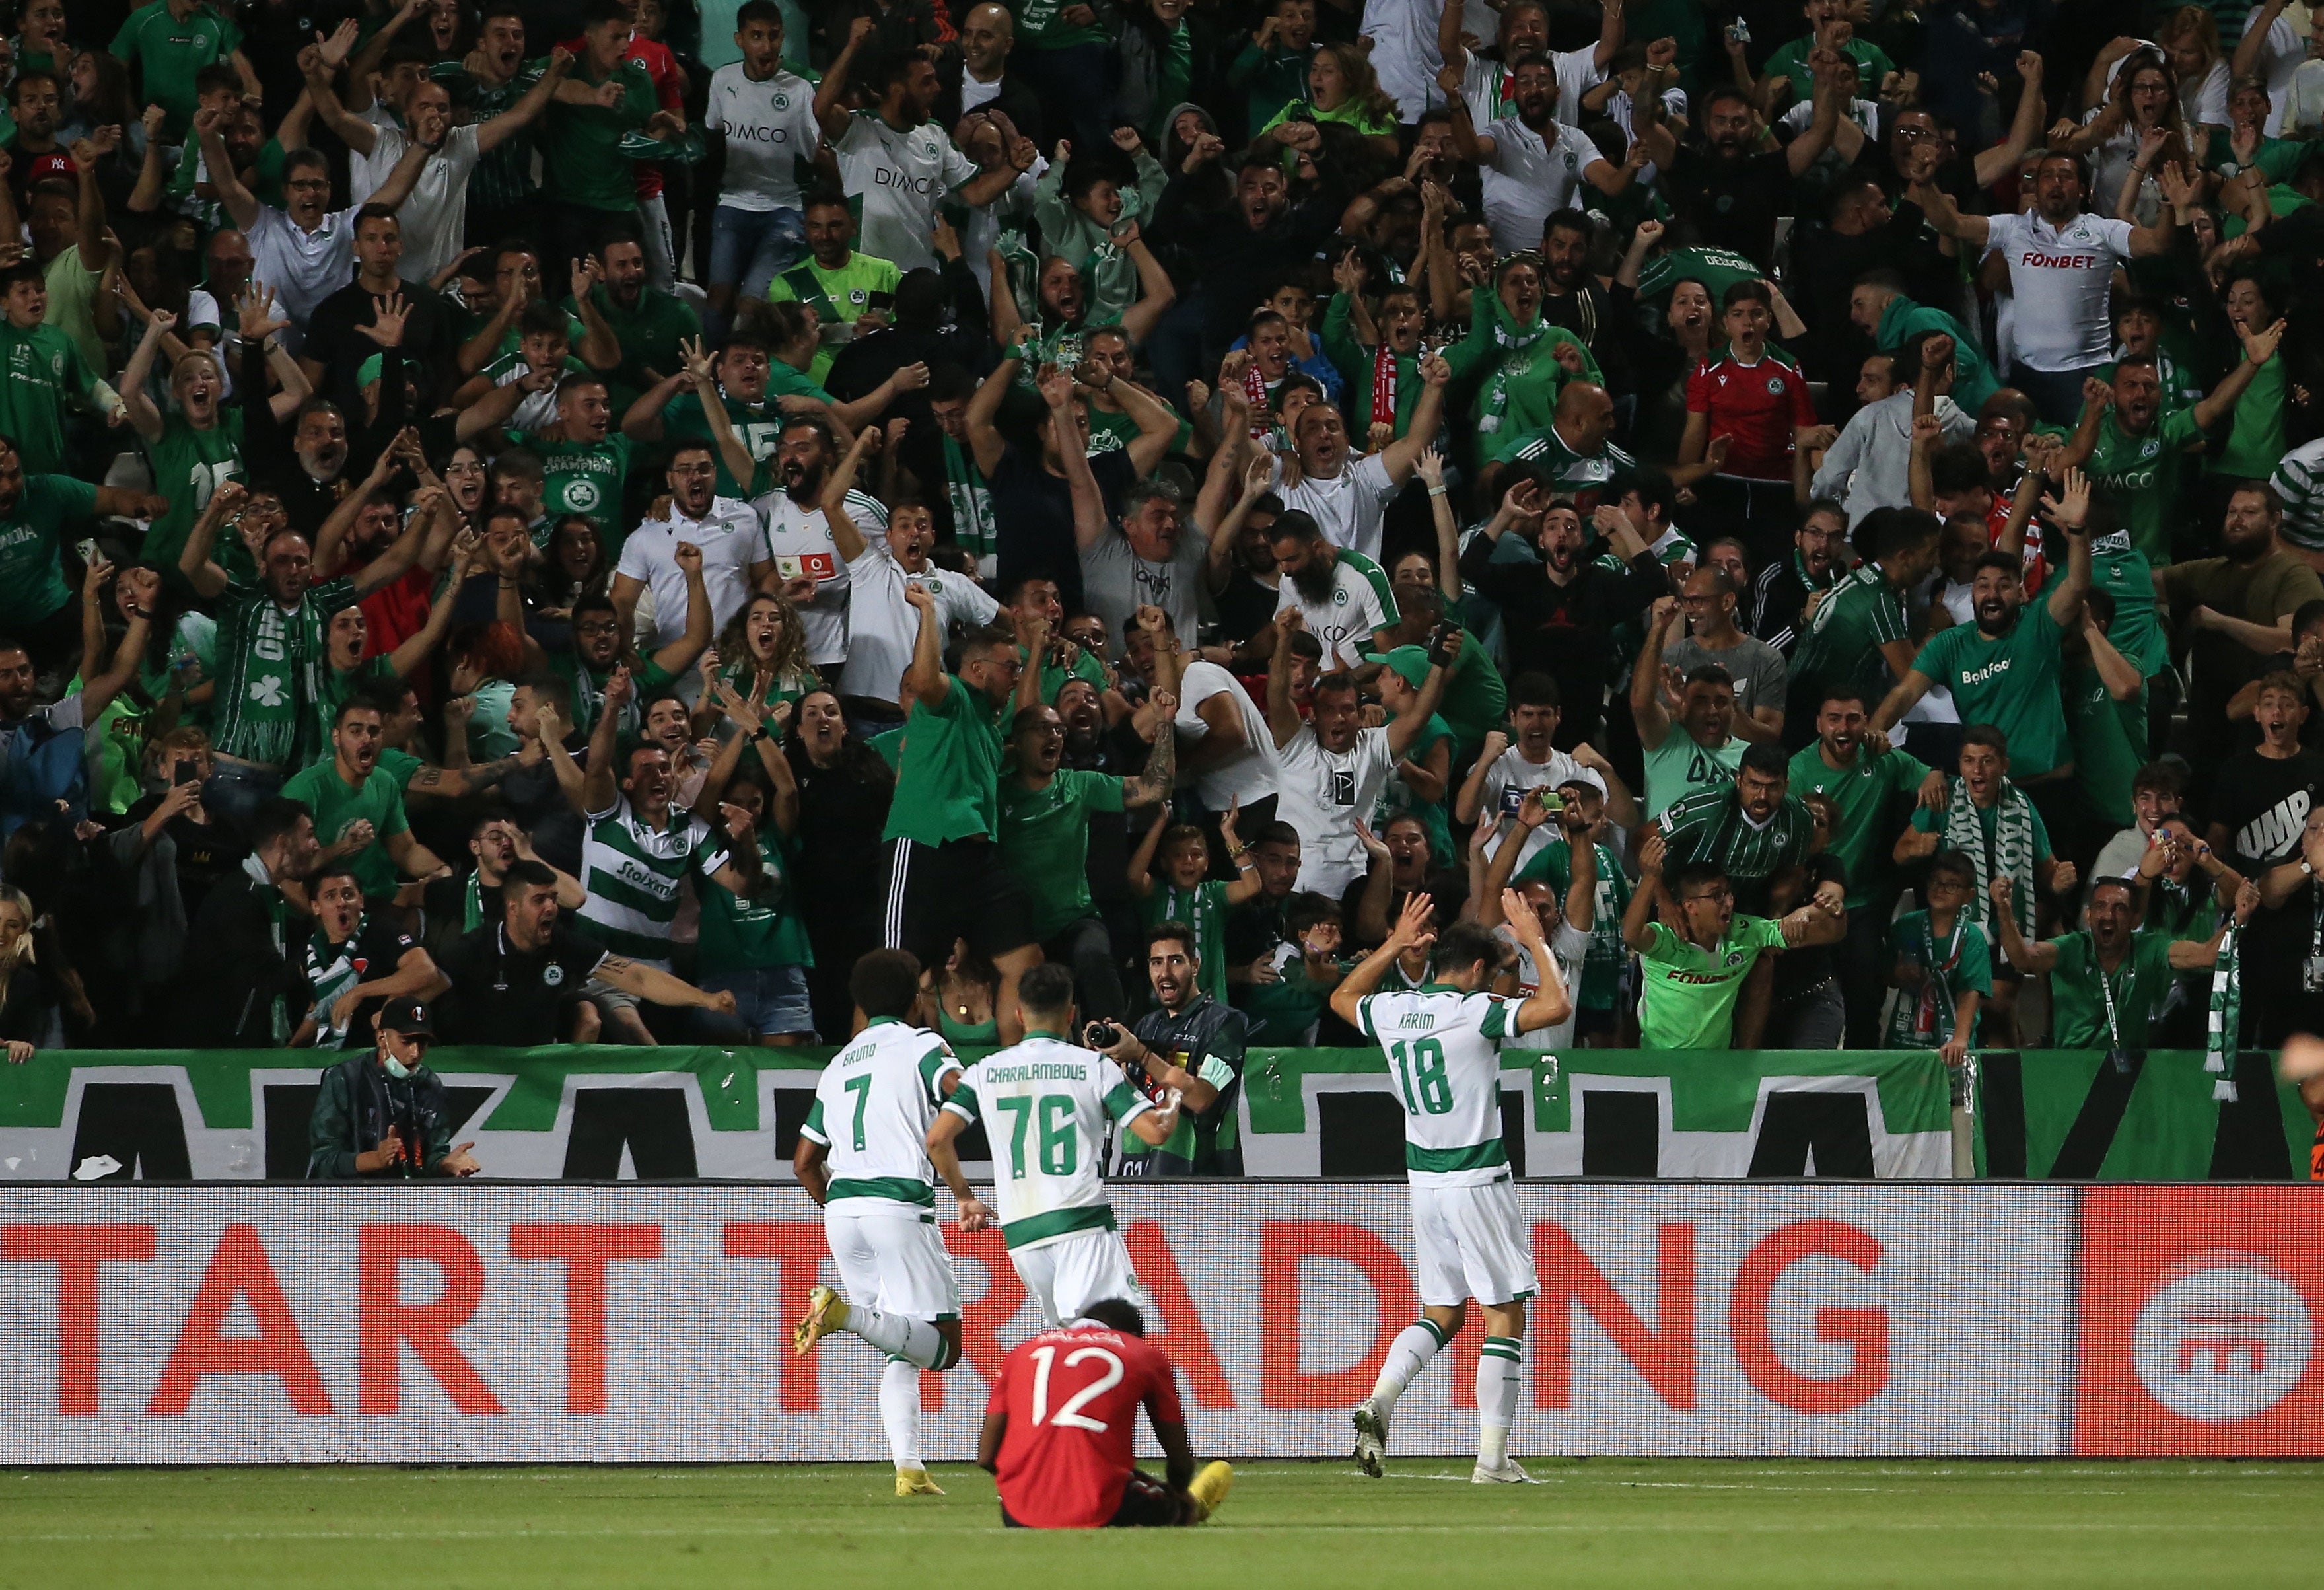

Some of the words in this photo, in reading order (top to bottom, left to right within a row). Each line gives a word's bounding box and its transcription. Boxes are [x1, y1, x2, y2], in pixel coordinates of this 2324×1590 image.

[724, 120, 787, 143] DIMCO
[2022, 252, 2095, 269] FONBET
[1253, 369, 1266, 400] GROUP
[543, 462, 617, 476] CHAMPIONS
[2097, 472, 2154, 489] IMCO
[1398, 1013, 1435, 1029] KARIM
[843, 1043, 877, 1067] BRUNO
[986, 1062, 1087, 1083] CHARALAMBOUS
[1391, 1038, 1454, 1116] 18
[845, 1073, 872, 1153] 7
[997, 1093, 1077, 1180] 76
[0, 1222, 661, 1415] TART
[1029, 1344, 1125, 1435] 12
